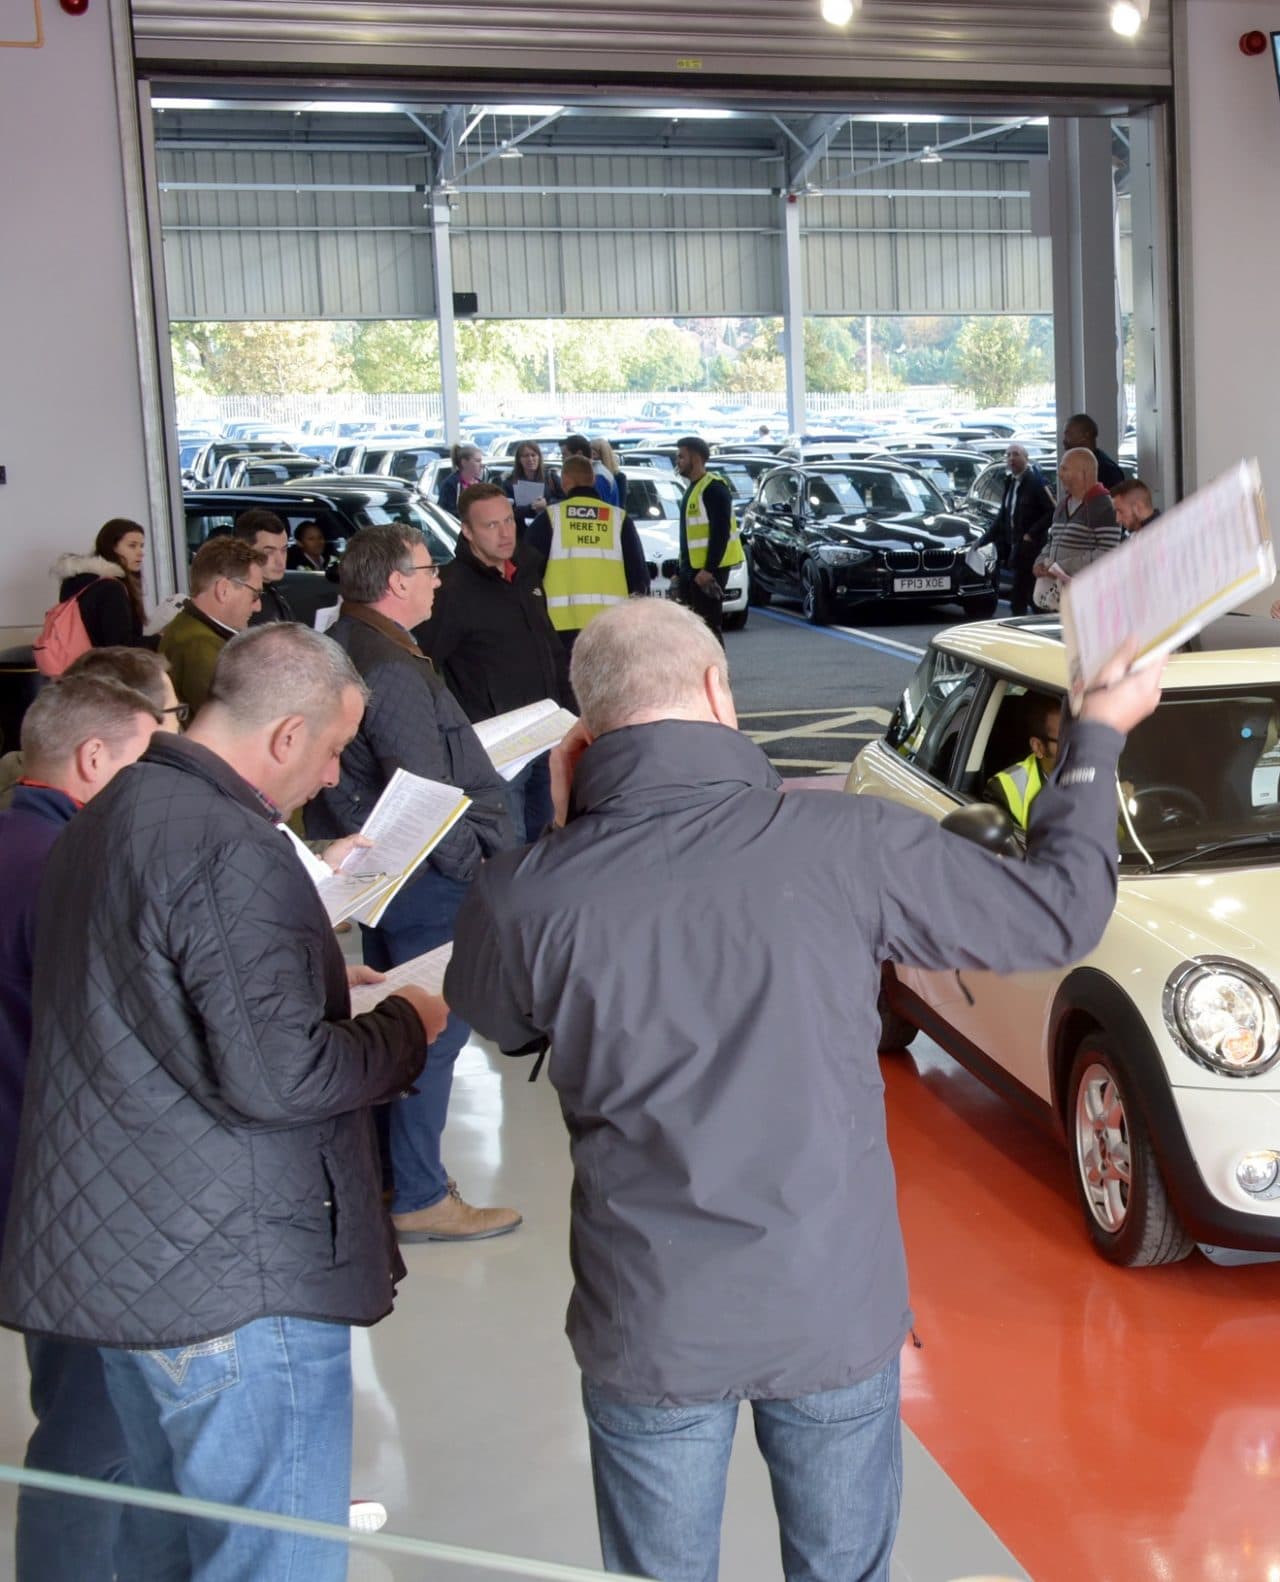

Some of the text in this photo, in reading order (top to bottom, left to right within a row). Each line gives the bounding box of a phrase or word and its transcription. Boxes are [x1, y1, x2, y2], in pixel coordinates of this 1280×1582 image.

[568, 507, 596, 518] BCA
[569, 522, 608, 532] HERE TO
[577, 535, 600, 544] HELP
